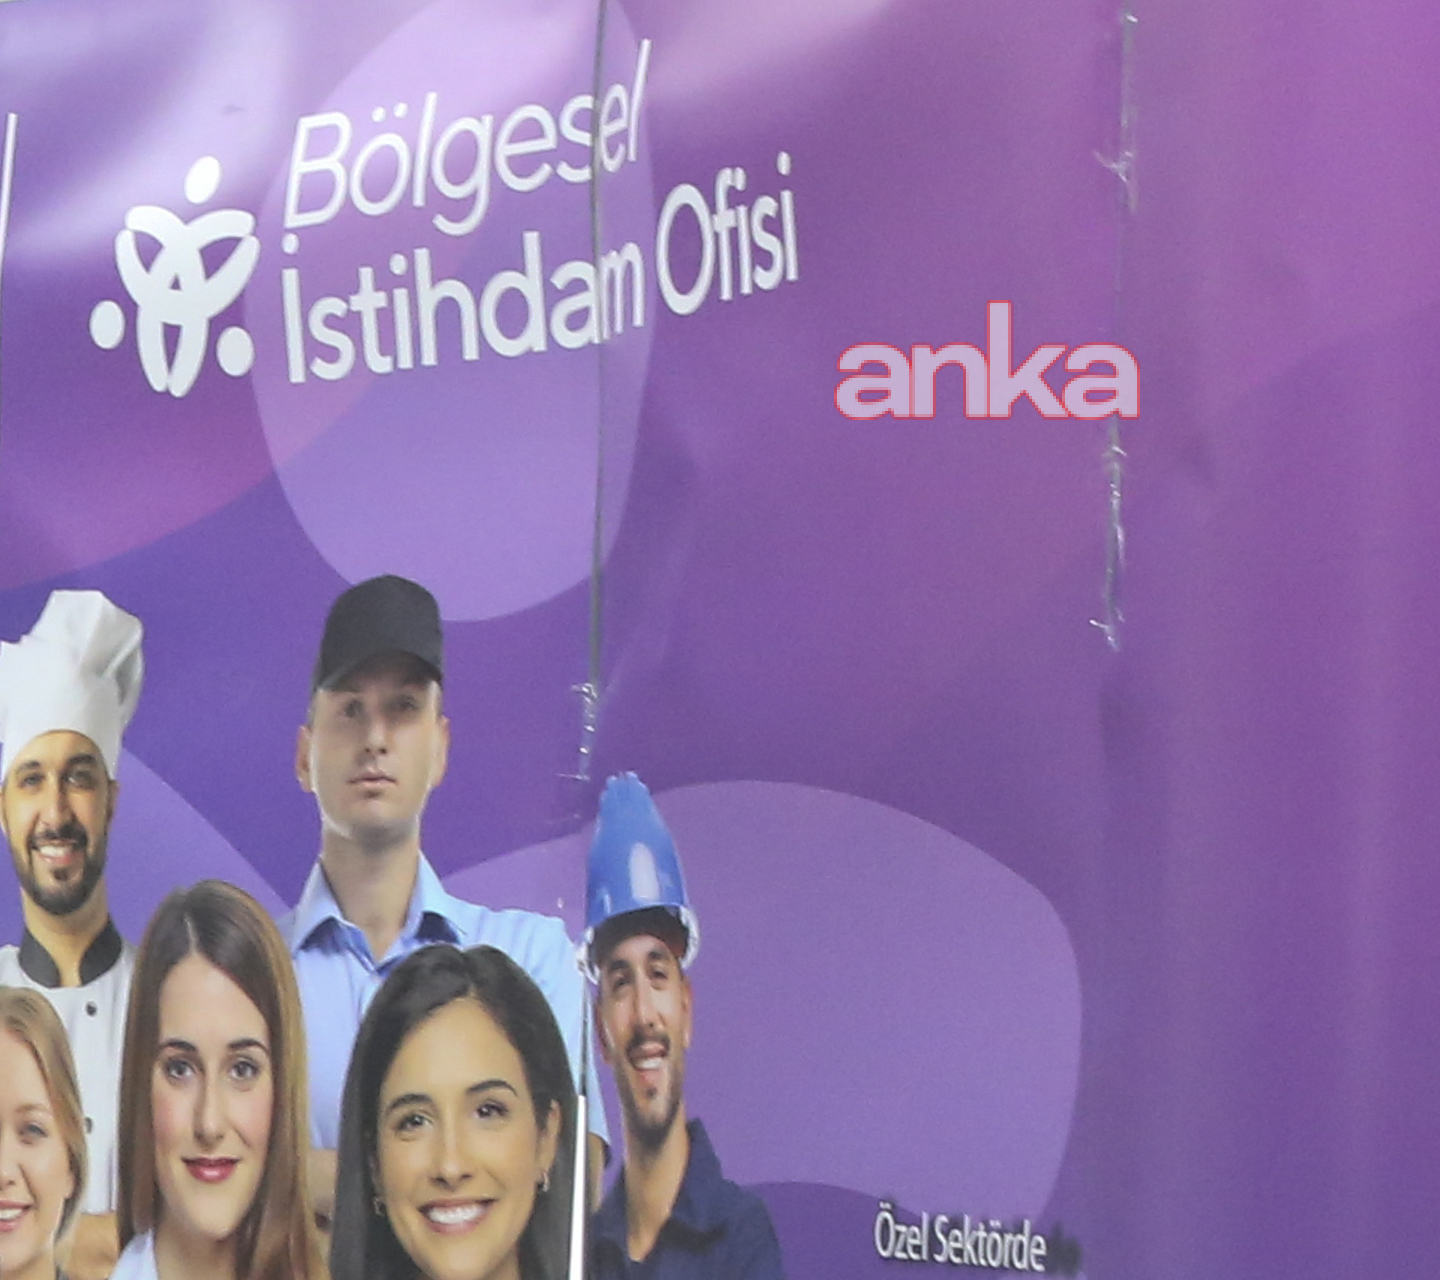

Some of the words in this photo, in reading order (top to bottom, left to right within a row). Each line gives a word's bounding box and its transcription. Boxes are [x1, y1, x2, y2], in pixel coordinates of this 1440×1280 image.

[284, 38, 651, 236] Bölgesel
[281, 231, 645, 384] İstihdam
[656, 151, 799, 316] Ofisi
[874, 1201, 929, 1262] Özel
[933, 1213, 1048, 1273] Sektörde
